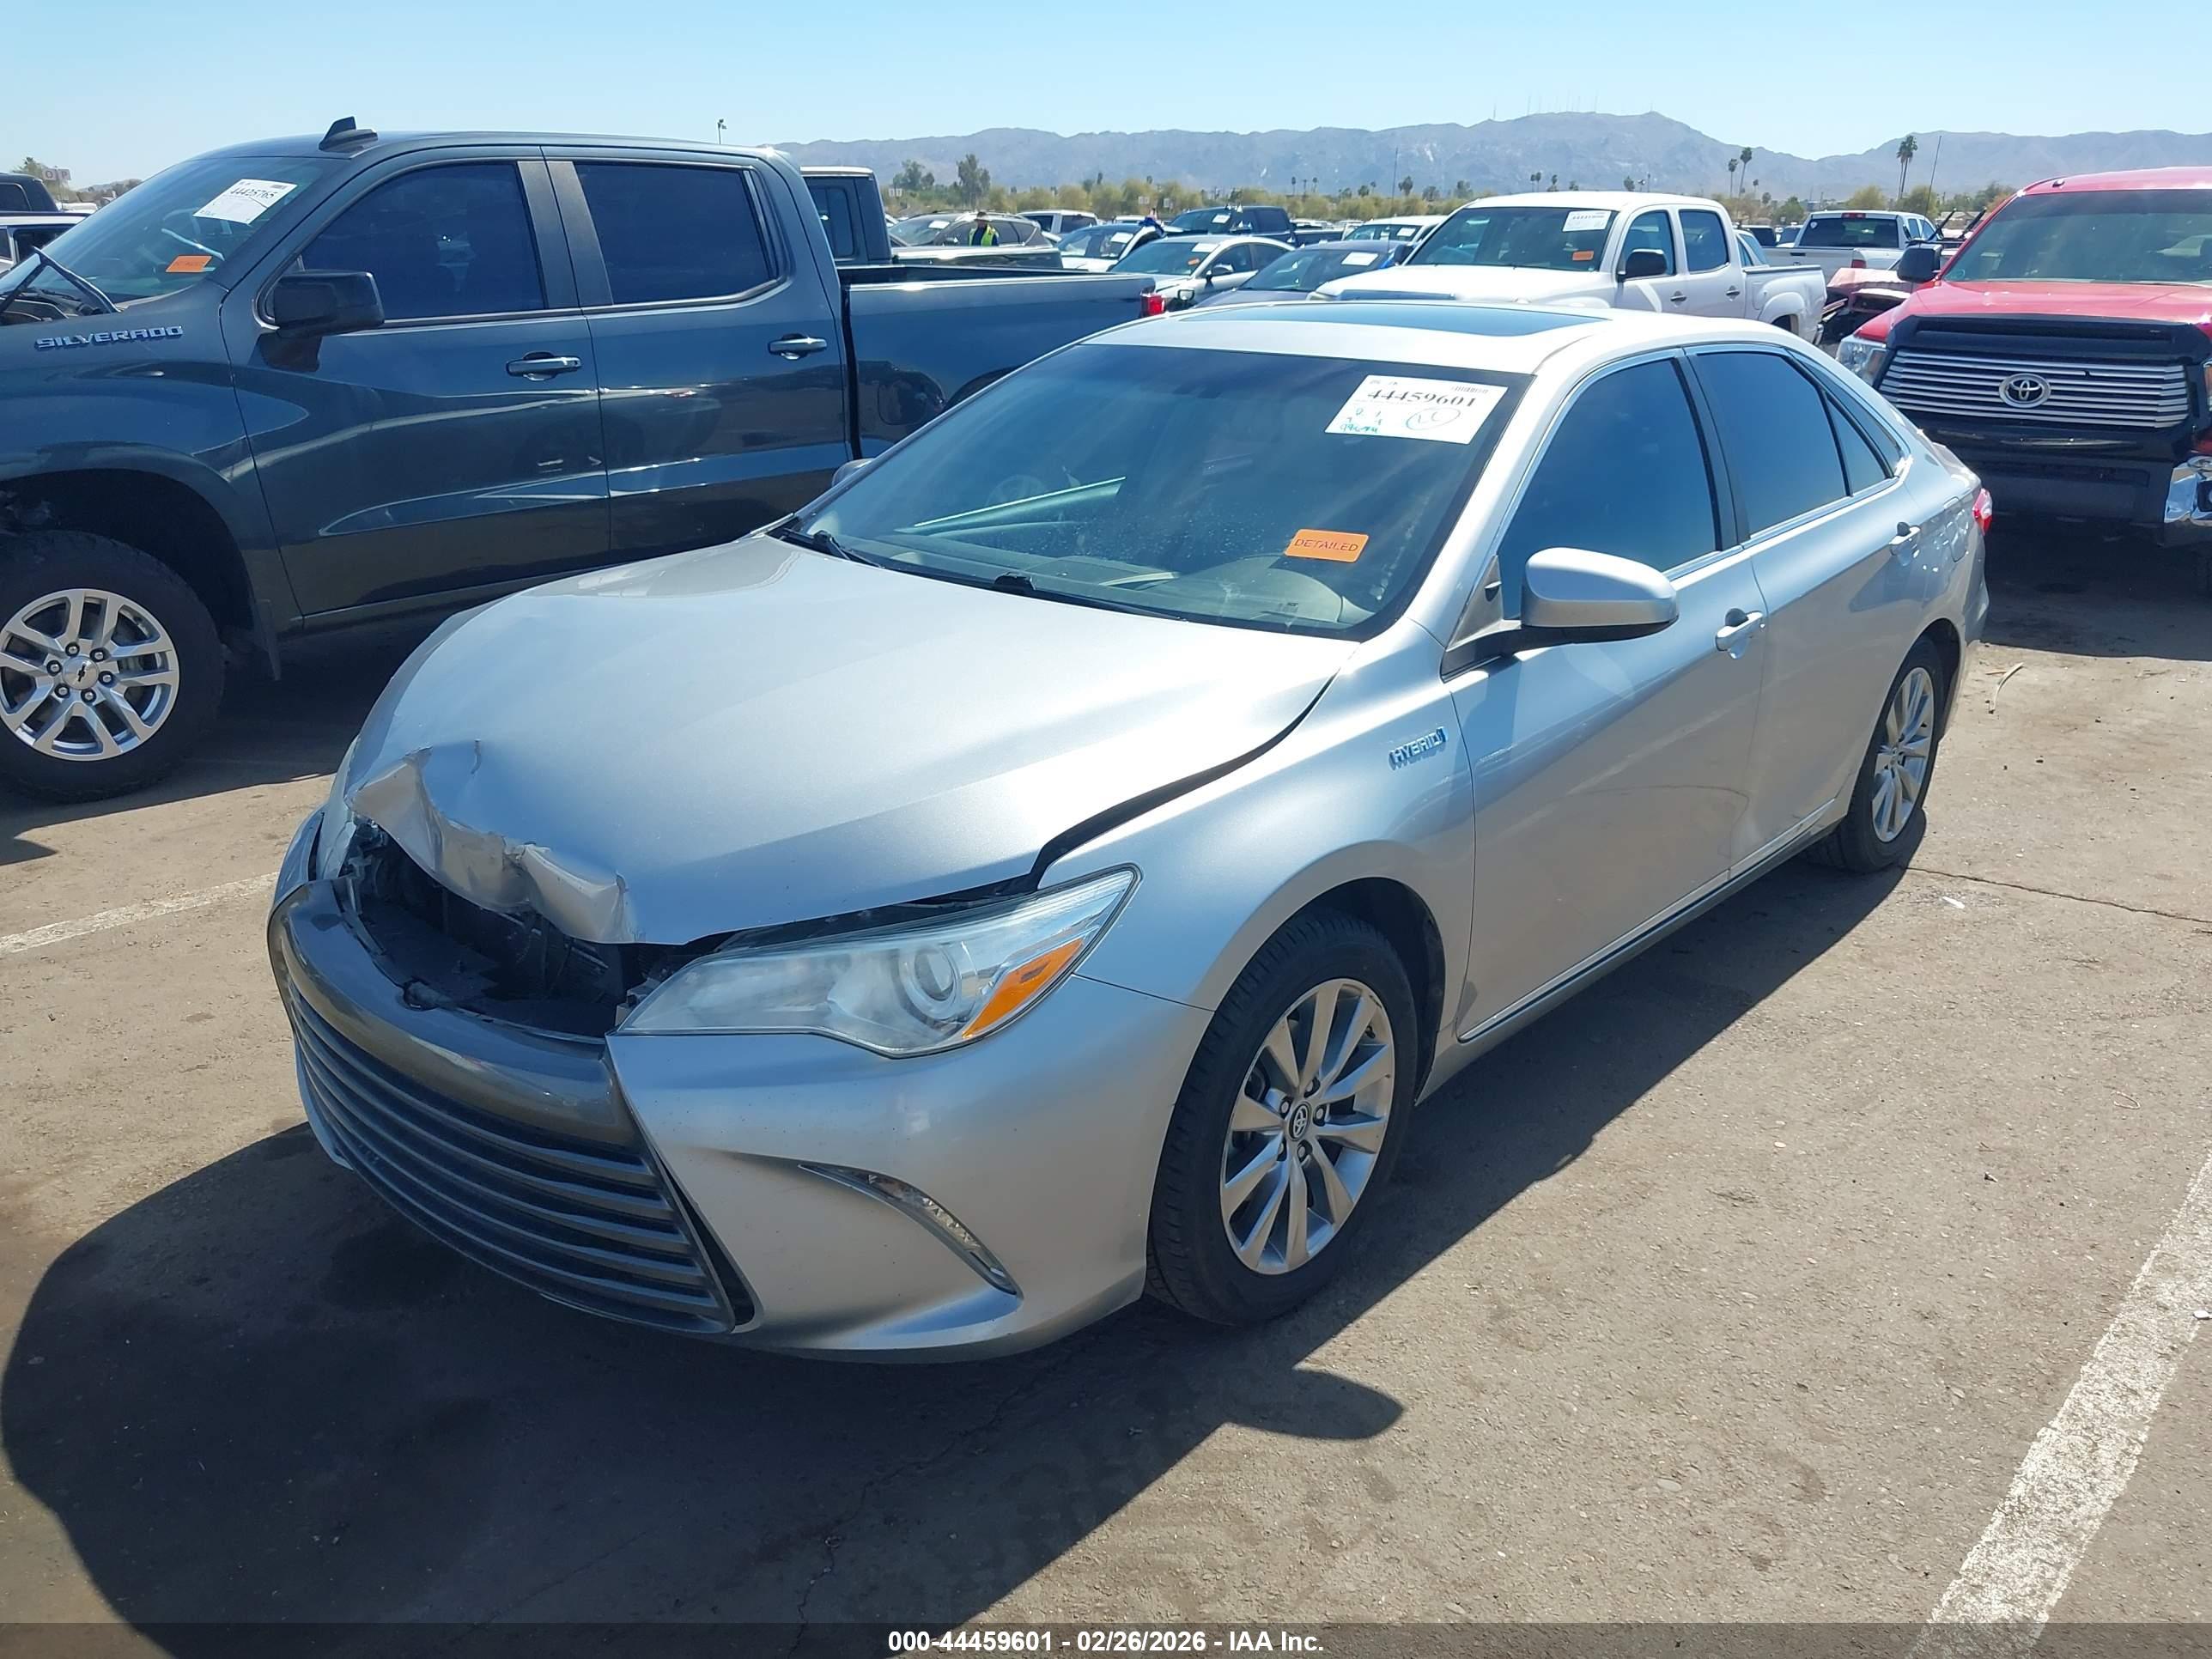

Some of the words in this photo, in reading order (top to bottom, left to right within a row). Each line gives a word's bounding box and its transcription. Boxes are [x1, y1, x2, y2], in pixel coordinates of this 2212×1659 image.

[36, 325, 184, 349] SILVERADO
[1367, 388, 1477, 408] 44459601
[1294, 538, 1358, 552] DETAILED
[1389, 726, 1446, 764] HYBRID
